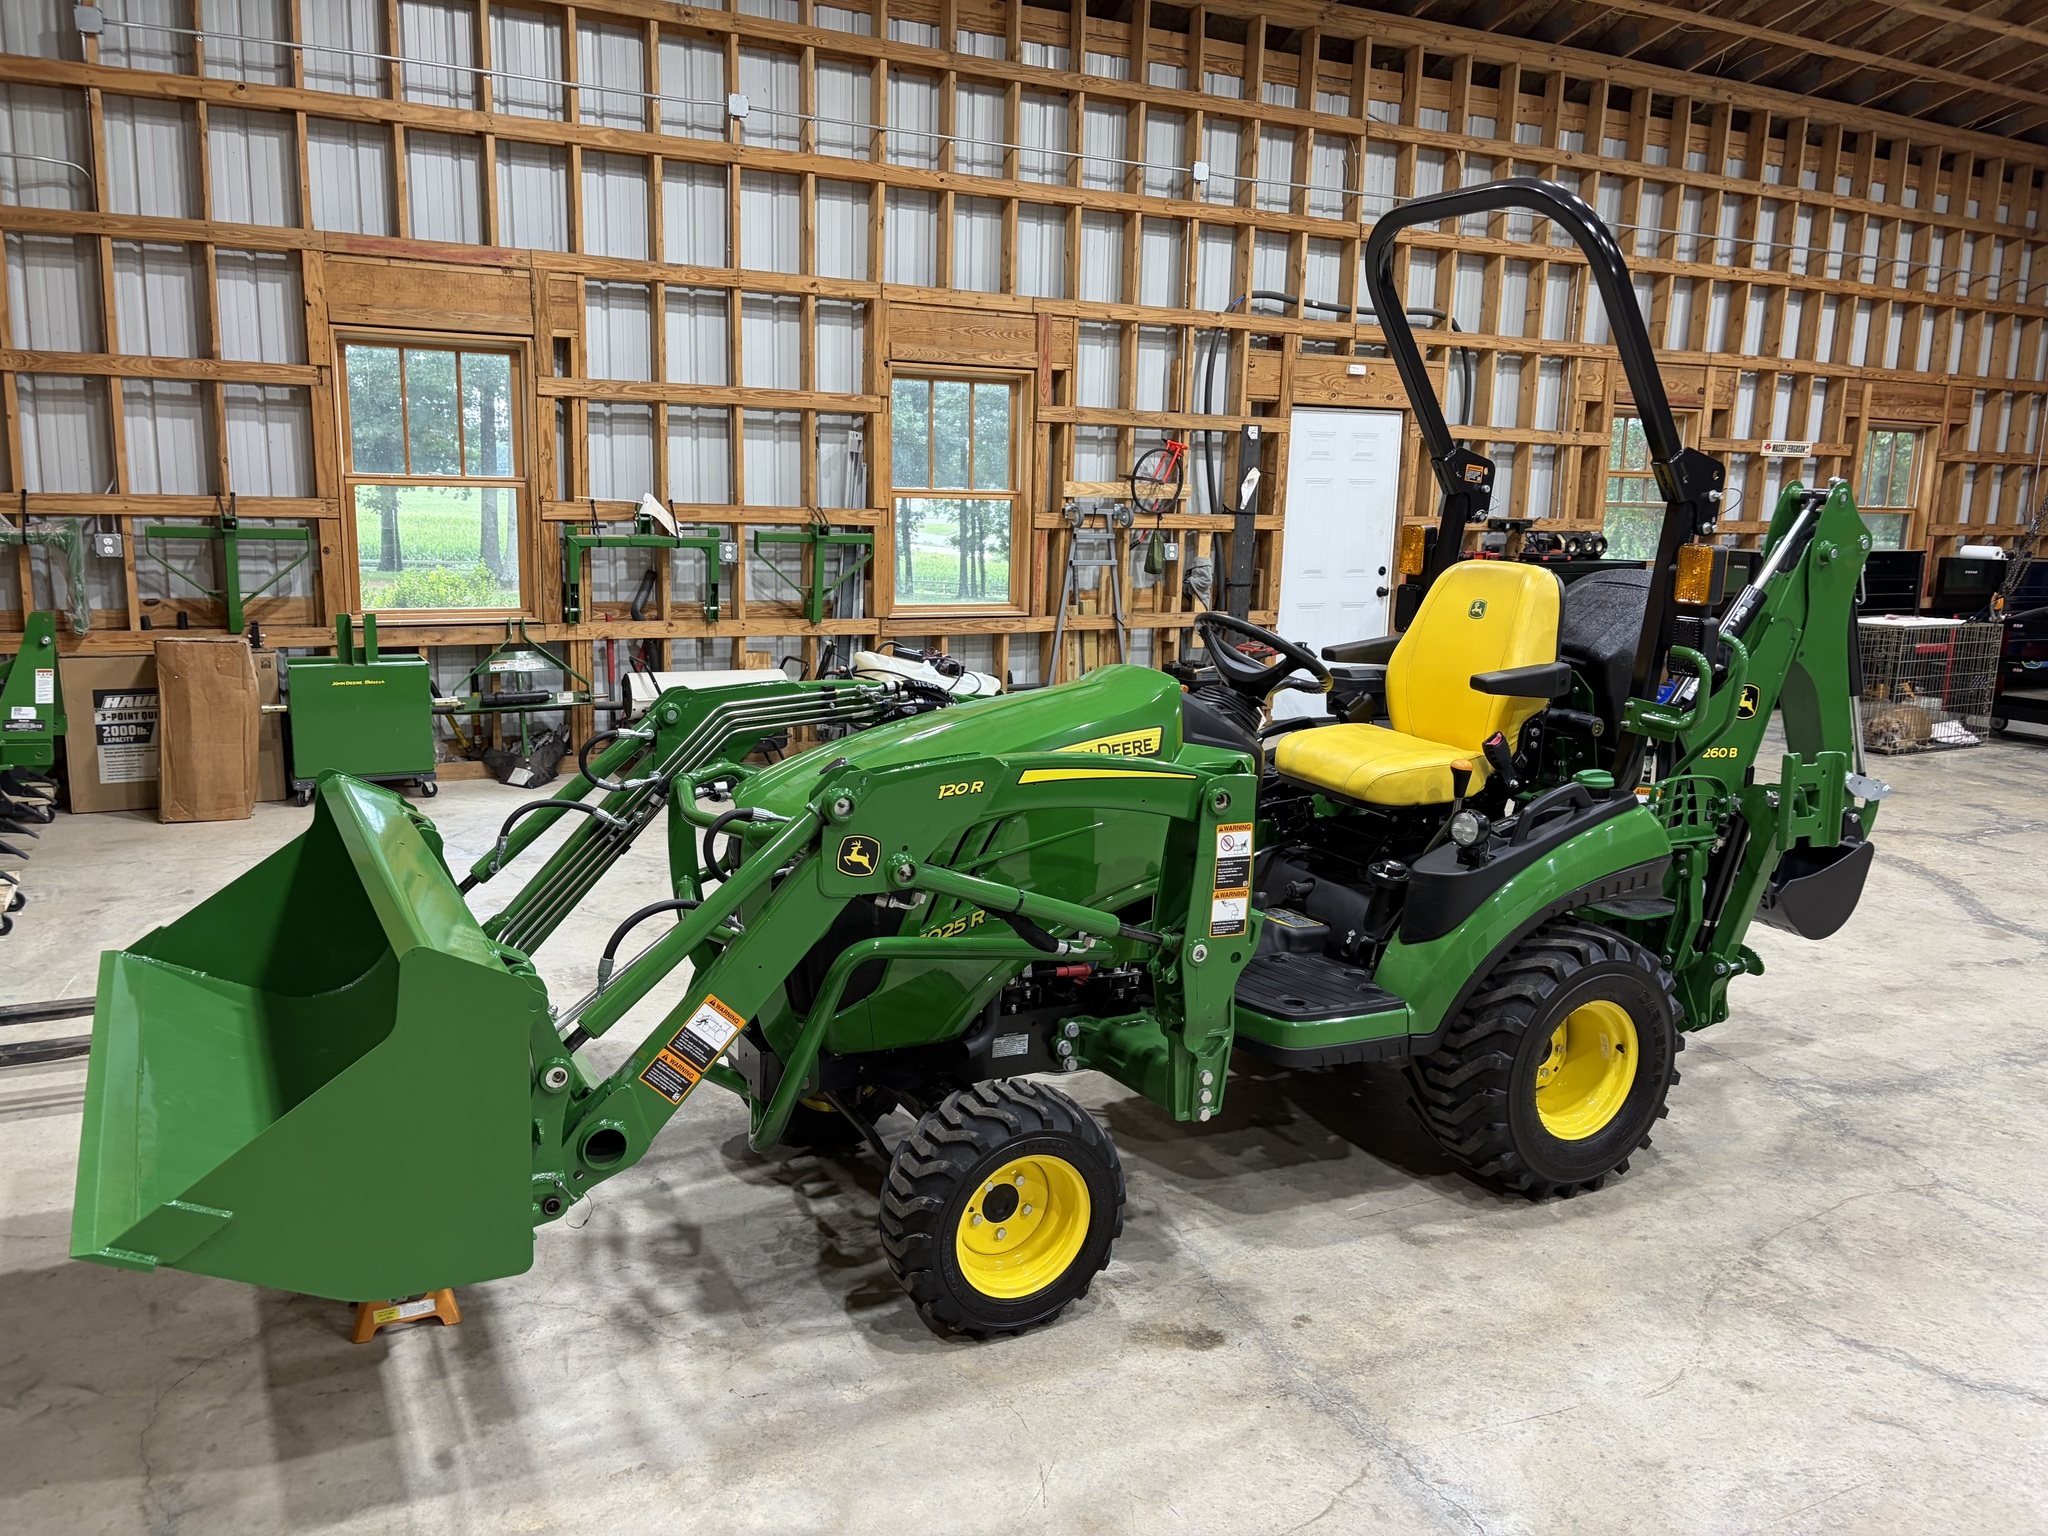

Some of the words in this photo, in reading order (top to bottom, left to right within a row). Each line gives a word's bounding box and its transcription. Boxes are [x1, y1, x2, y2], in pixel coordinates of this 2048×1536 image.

[100, 712, 139, 721] 3-POINT
[1097, 738, 1154, 756] DEERE
[1223, 824, 1251, 832] WARNING
[1220, 890, 1247, 898] WARNING
[920, 916, 967, 938] 025
[715, 1003, 740, 1025] WARNING
[669, 1058, 695, 1080] WARNING
